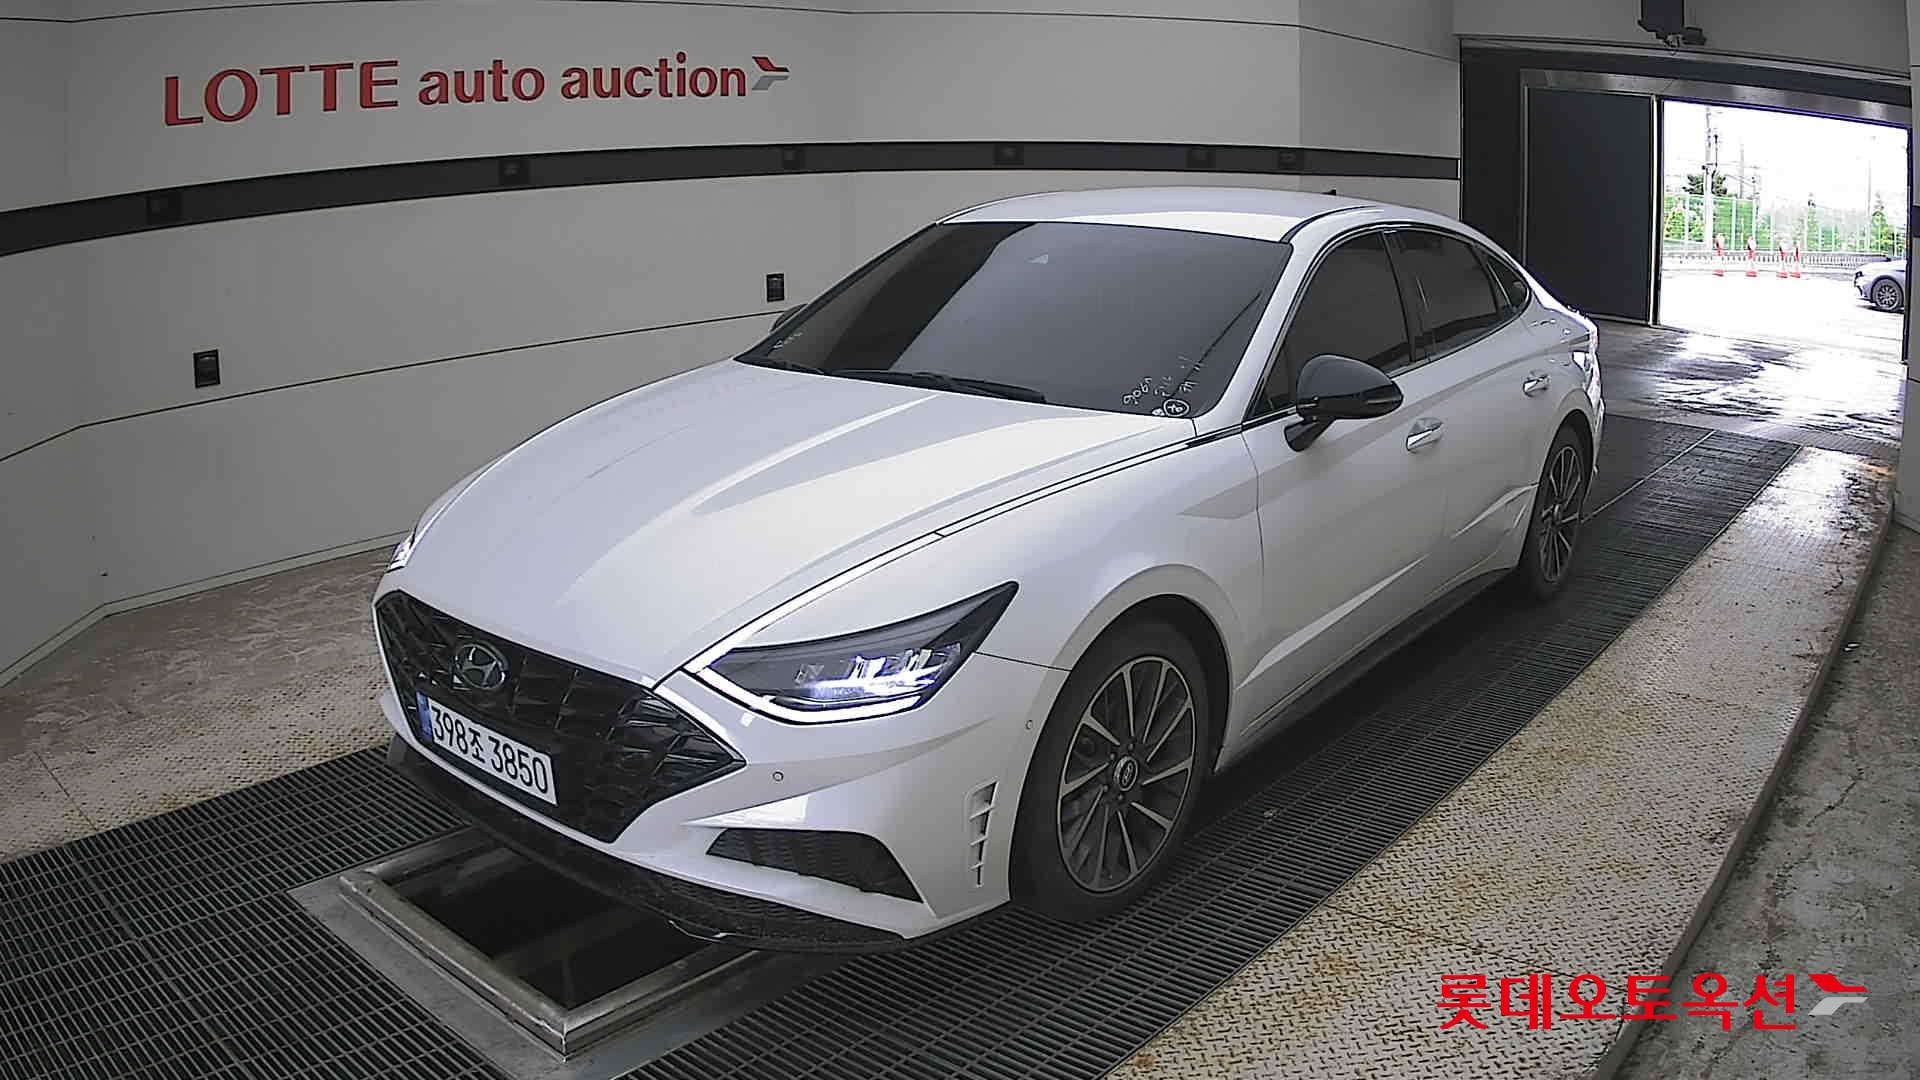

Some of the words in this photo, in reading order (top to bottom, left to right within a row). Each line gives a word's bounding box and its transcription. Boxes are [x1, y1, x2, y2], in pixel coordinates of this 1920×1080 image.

[164, 60, 399, 126] LOTTE
[418, 60, 545, 105] auto
[561, 51, 747, 99] auction
[431, 707, 486, 763] 398조
[488, 735, 549, 794] 3850
